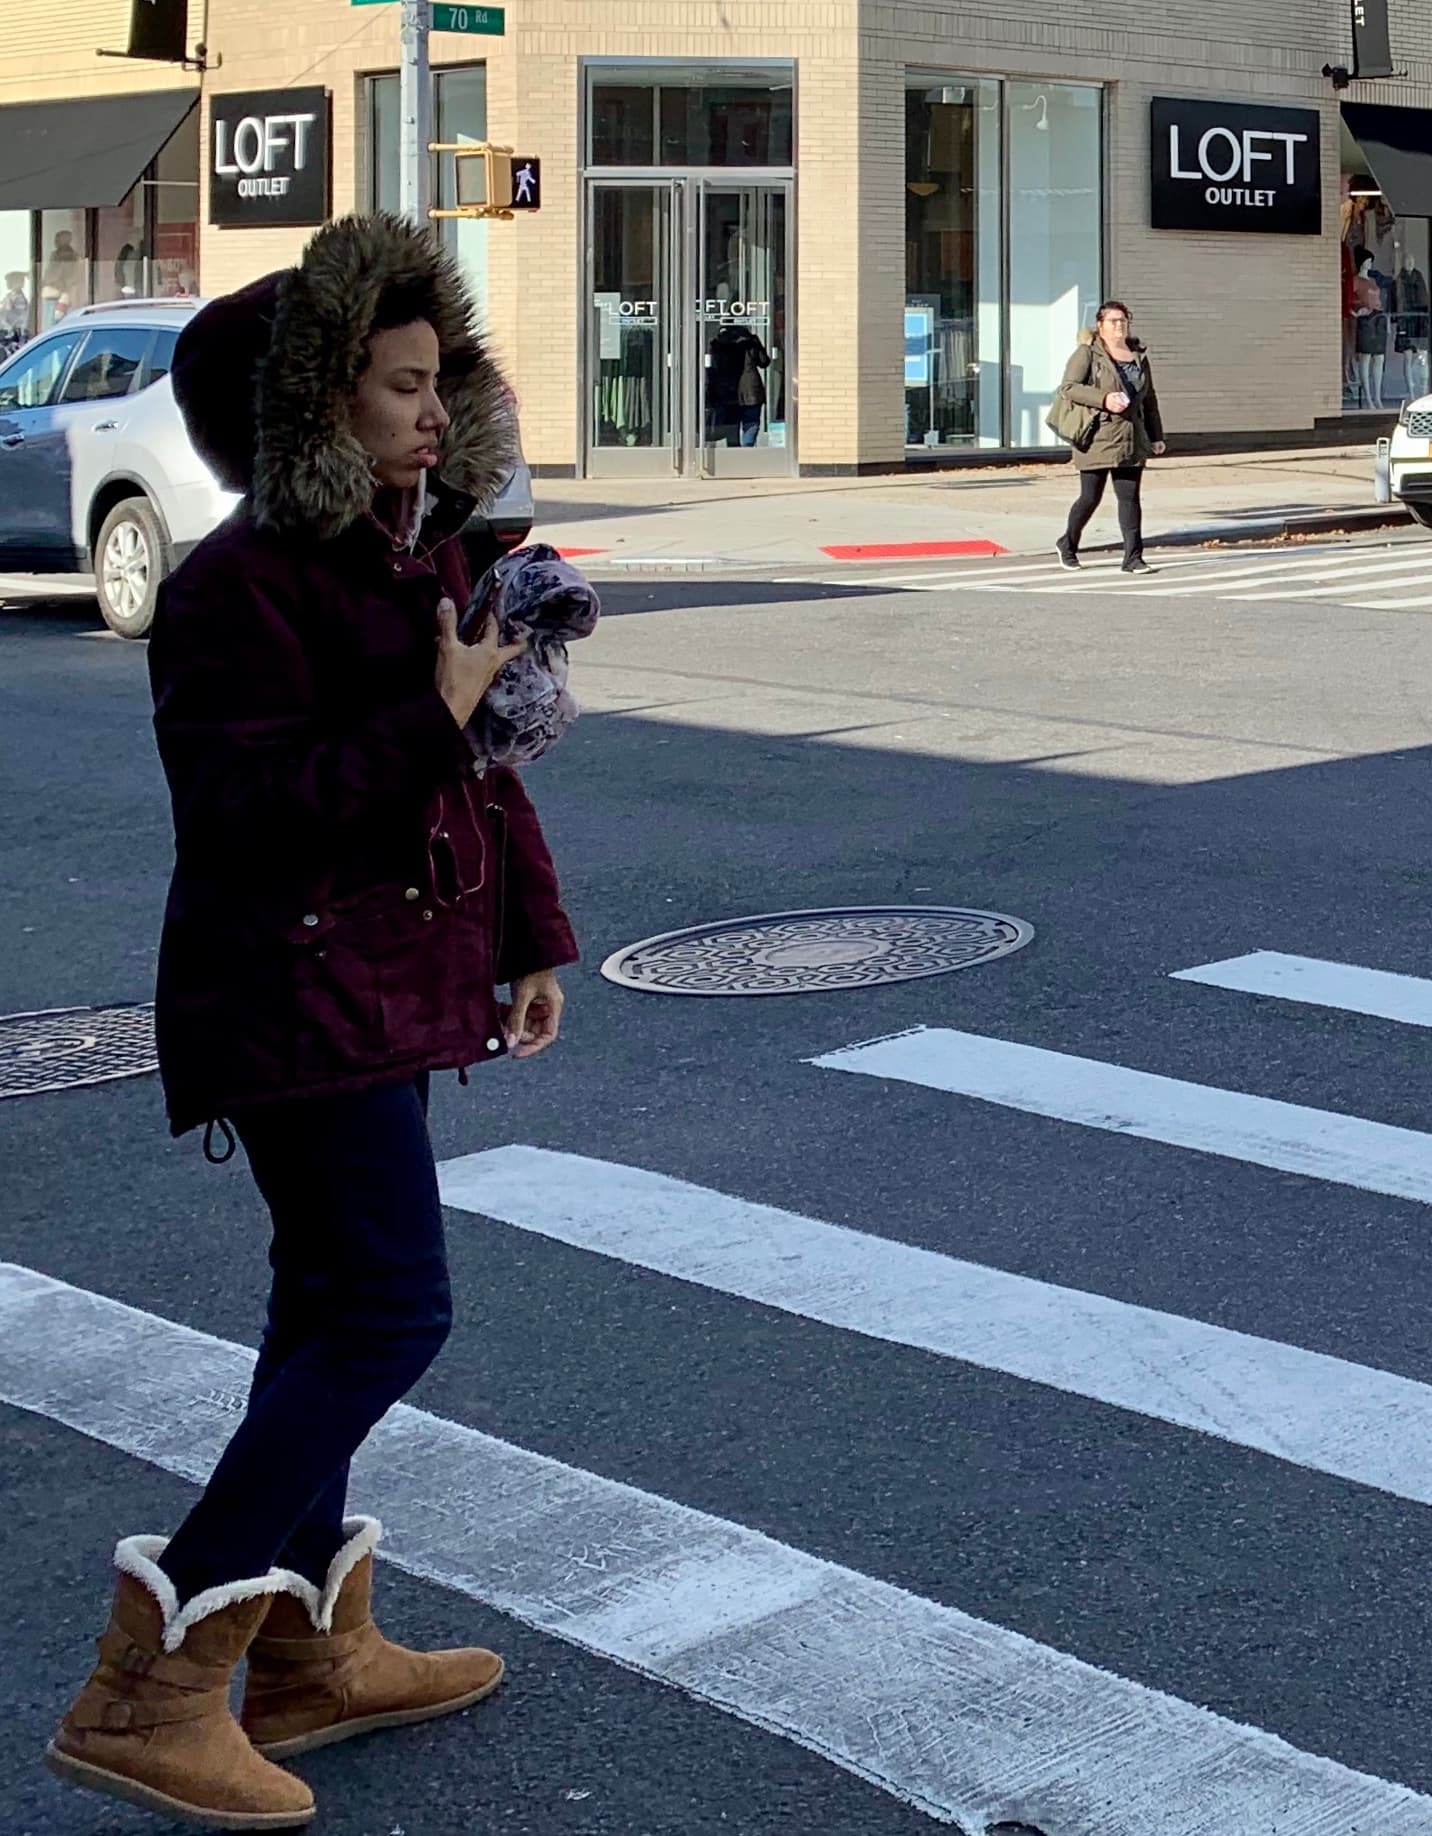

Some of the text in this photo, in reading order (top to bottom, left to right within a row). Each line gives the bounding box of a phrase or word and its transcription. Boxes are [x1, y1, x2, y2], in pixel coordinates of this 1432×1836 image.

[448, 7, 488, 30] 70 Rd
[215, 113, 316, 174] LOFT
[1170, 124, 1308, 185] LOFT
[238, 177, 291, 197] OUTLET
[1205, 187, 1276, 207] OUTLET
[608, 301, 658, 316] LOFT
[720, 301, 770, 316] LOFT
